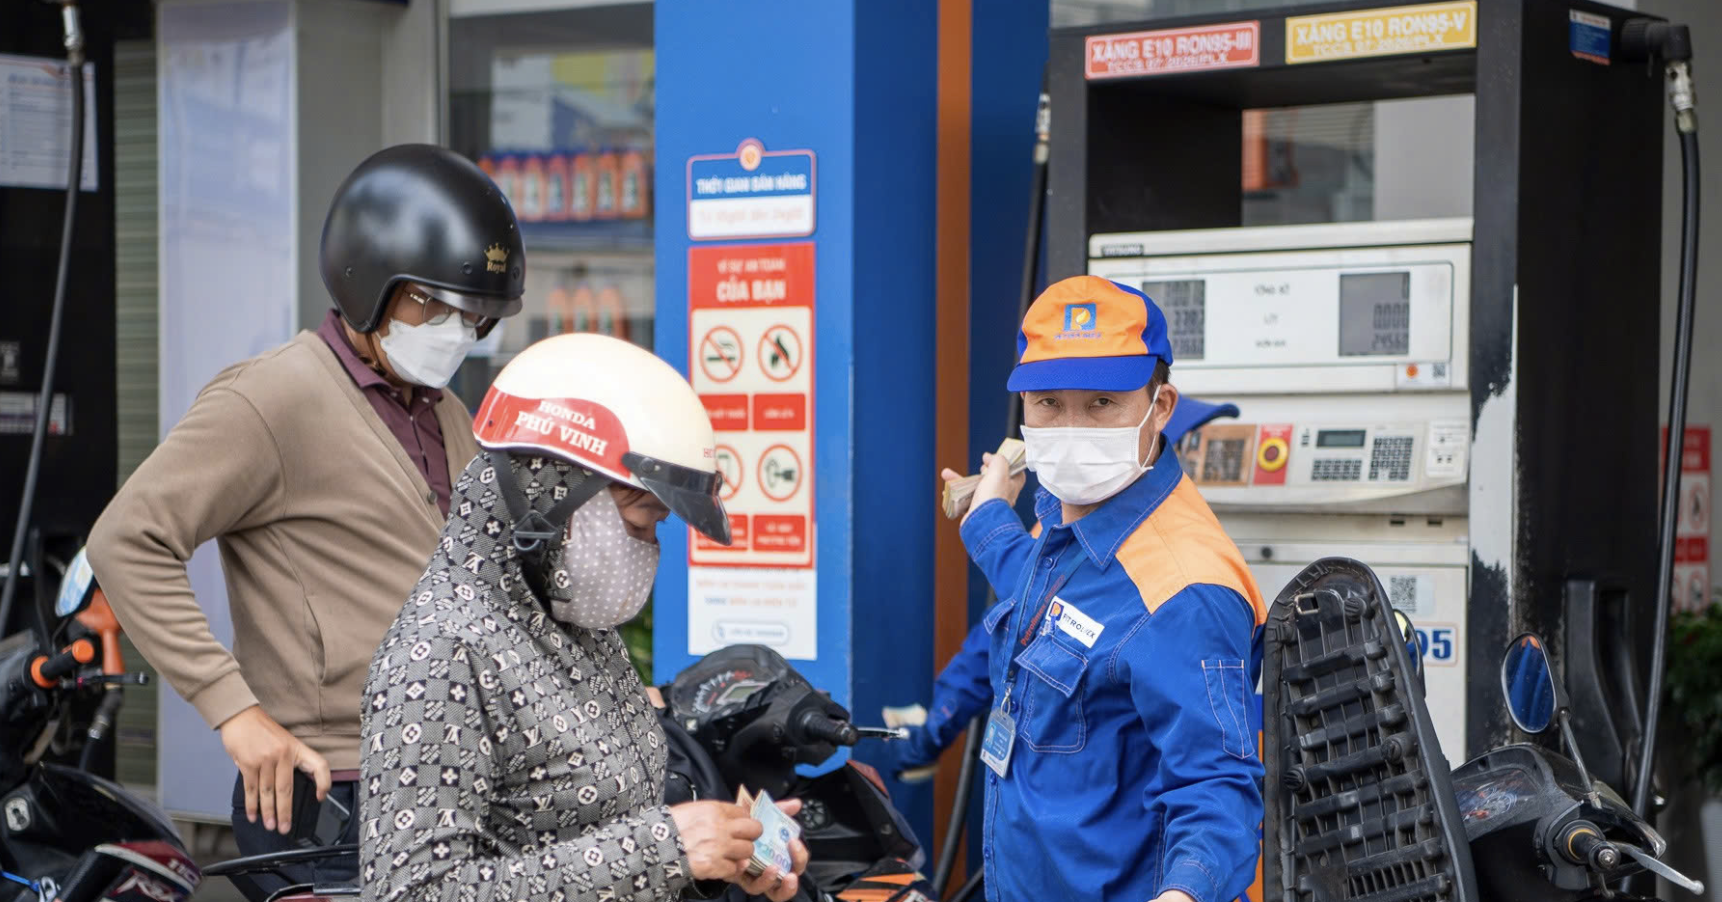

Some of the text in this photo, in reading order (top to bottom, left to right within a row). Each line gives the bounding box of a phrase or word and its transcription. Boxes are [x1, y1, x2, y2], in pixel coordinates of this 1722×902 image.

[1296, 12, 1467, 45] XĂNG E10 RON95-V
[1092, 39, 1140, 62] XĂNG
[1142, 38, 1174, 59] E10
[487, 261, 507, 274] Royal
[716, 275, 750, 302] CỦA
[537, 400, 596, 431] HONDA
[514, 410, 609, 457] PHÚ VINH
